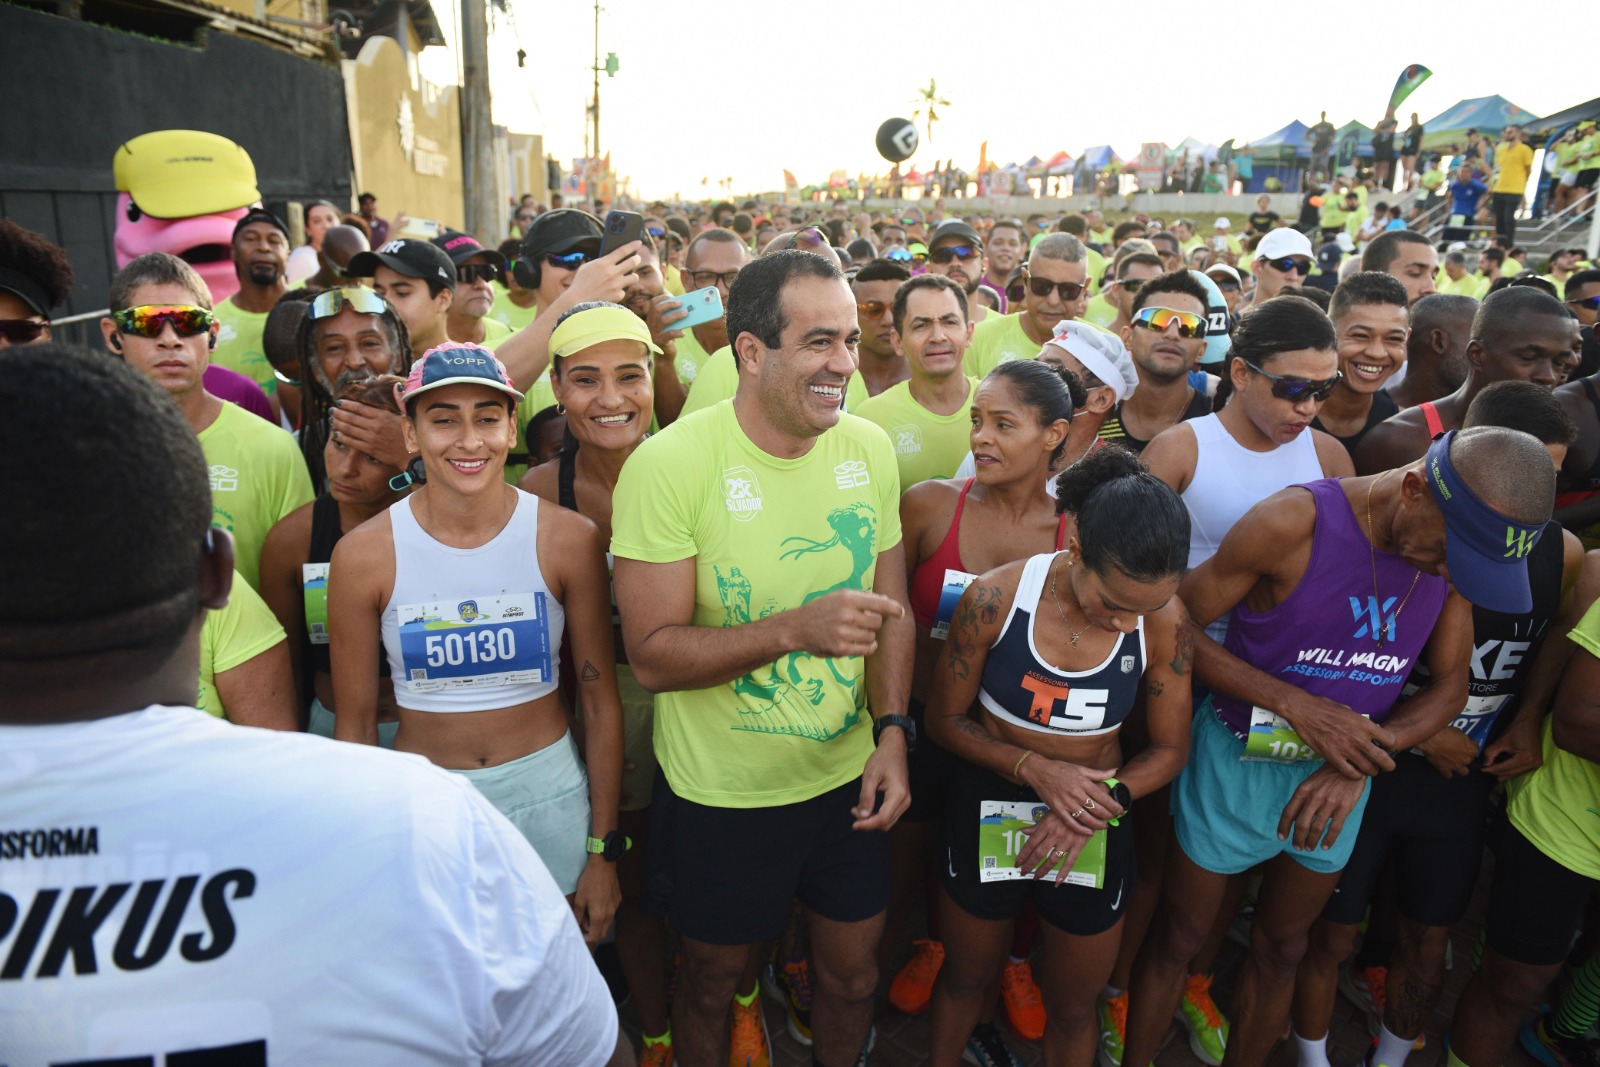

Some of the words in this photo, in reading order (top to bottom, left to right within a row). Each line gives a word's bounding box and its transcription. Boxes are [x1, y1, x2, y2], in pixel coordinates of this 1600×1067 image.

[443, 357, 487, 366] YOPP
[725, 497, 764, 512] SALVADOR
[425, 627, 516, 667] 50130
[1296, 648, 1345, 667] WILL
[1467, 639, 1532, 681] KE
[1026, 670, 1069, 688] ASSESSORIA
